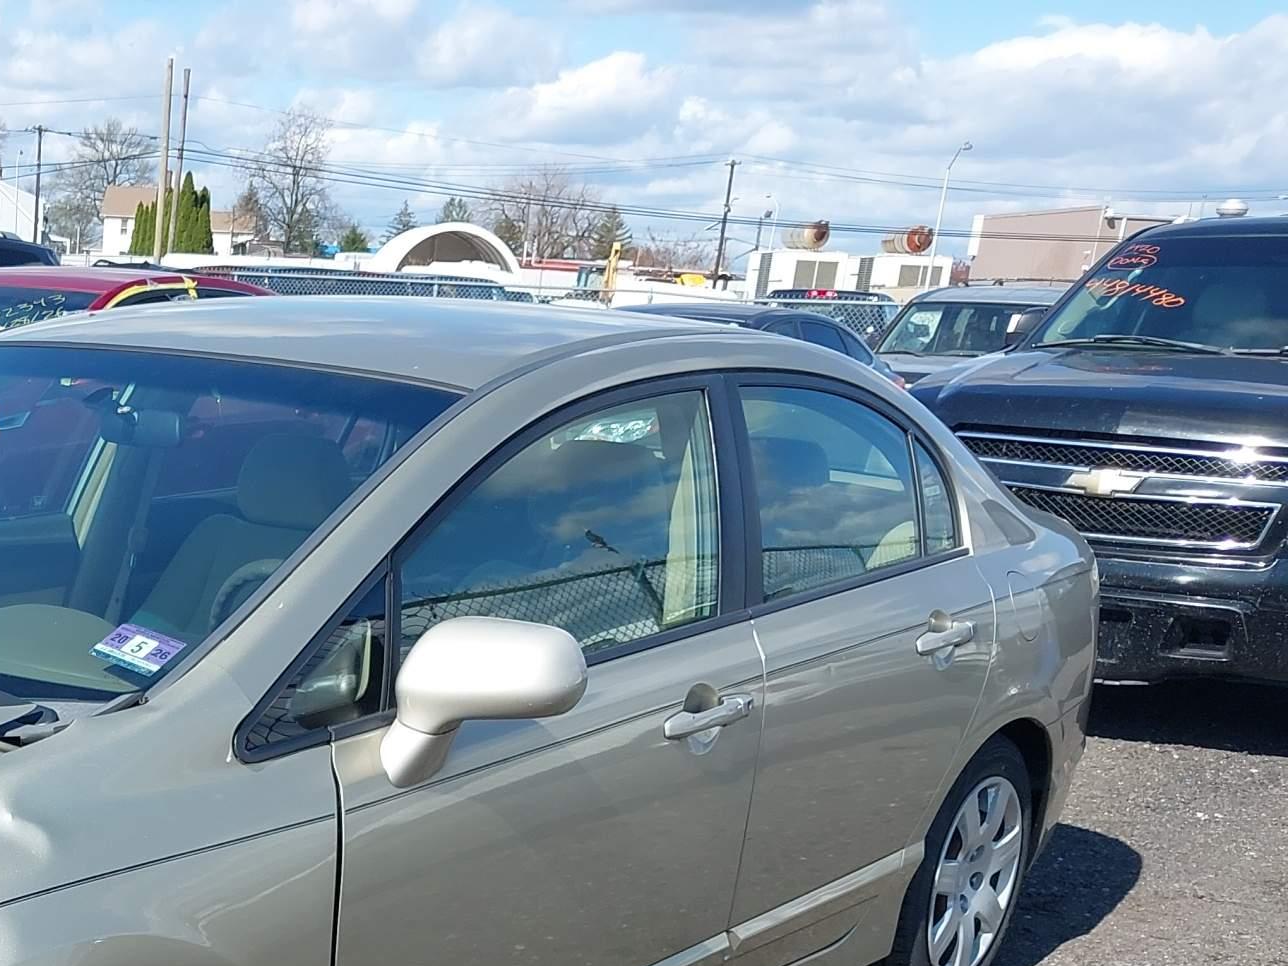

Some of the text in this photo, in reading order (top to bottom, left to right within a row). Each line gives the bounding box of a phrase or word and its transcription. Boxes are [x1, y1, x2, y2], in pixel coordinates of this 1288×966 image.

[110, 632, 130, 645] 20
[130, 641, 149, 654] 5
[150, 648, 172, 661] 26
